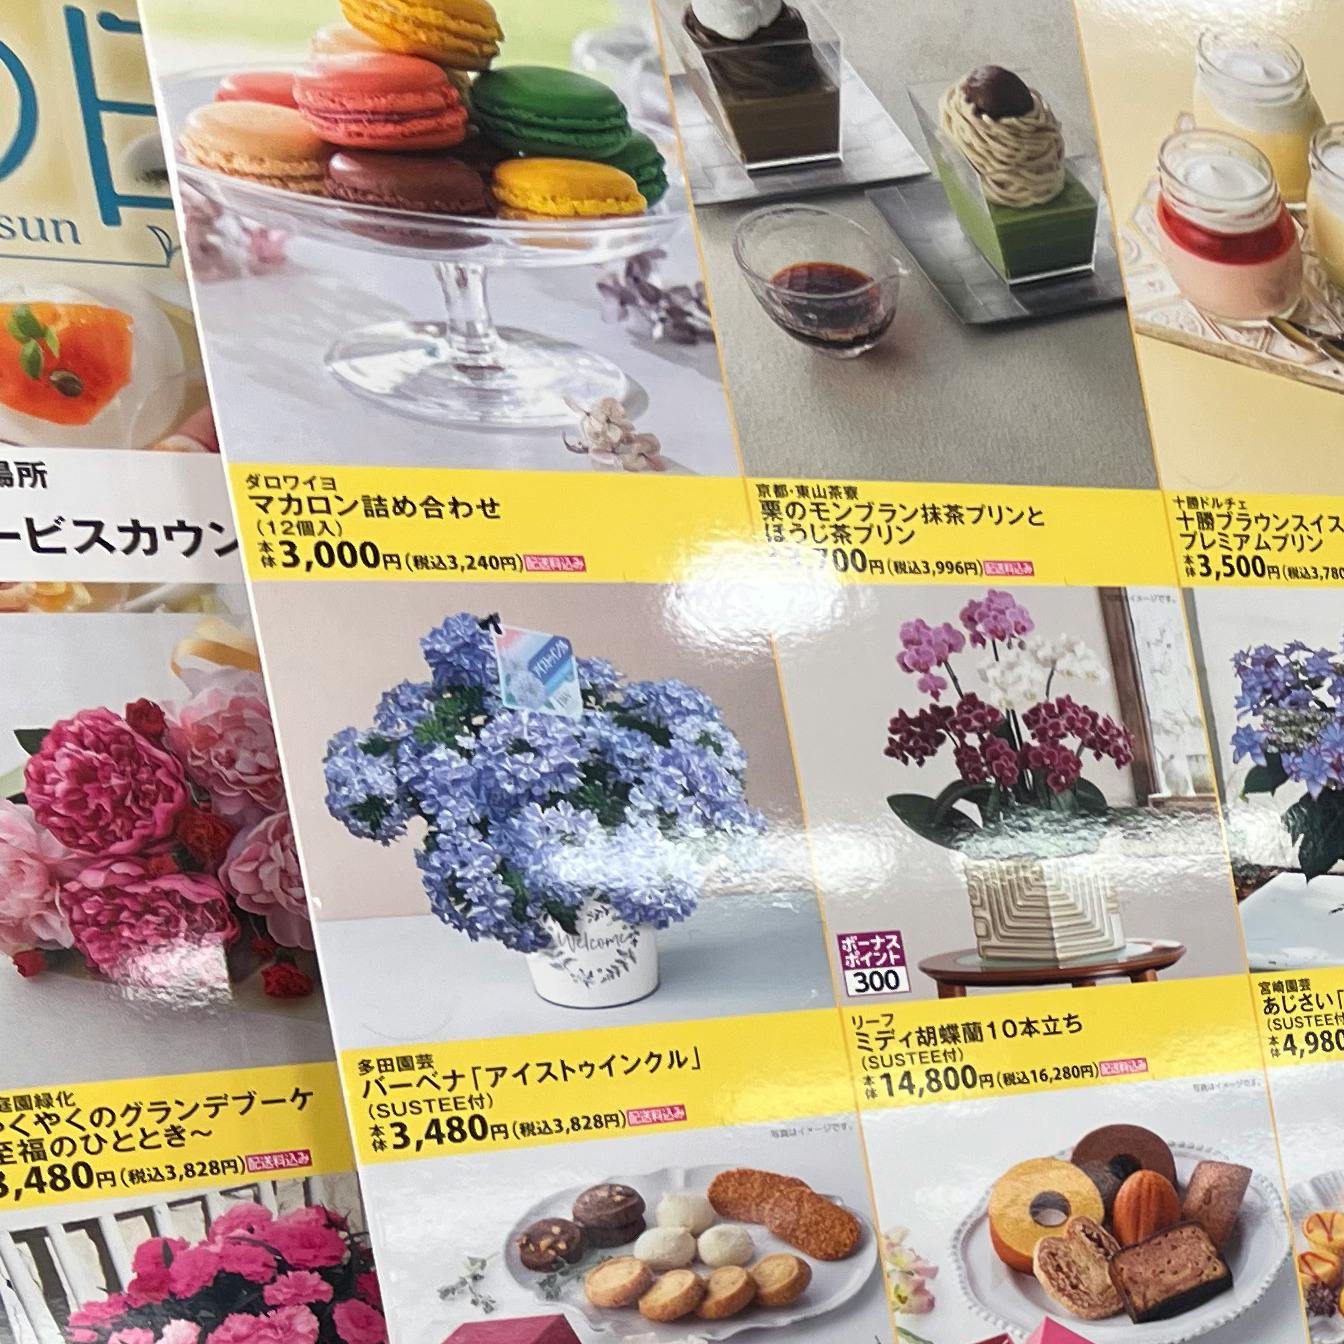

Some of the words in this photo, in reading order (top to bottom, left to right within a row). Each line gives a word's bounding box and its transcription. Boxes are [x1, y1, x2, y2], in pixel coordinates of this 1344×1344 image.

[245, 472, 338, 492] ダロワイヨ
[248, 494, 500, 520] マカロン詰め合わせ
[761, 500, 1045, 526] 栗のモンブラン抹茶プリンと
[1172, 496, 1247, 511] 十勝ドルチェ
[256, 519, 343, 538] (12個入)
[1176, 512, 1344, 533] 十勝ブラウンスイス
[765, 523, 915, 544] ほうじ茶プリン
[1180, 532, 1324, 552] プレミアムプリン
[841, 934, 900, 951] ボーナス
[845, 950, 900, 967] ポイント
[854, 970, 900, 994] 300
[852, 1013, 894, 1029] リーフ
[855, 1013, 1083, 1052] ミディ胡蝶蘭10本立ち
[357, 1054, 434, 1074] 多田園芸
[860, 1049, 964, 1070] (SUSTEE付)
[362, 1046, 701, 1098] バーベナ「アイストゥインクル」
[368, 1094, 493, 1120] (SUSTEE付)
[245, 1149, 312, 1171] 配送料込み
